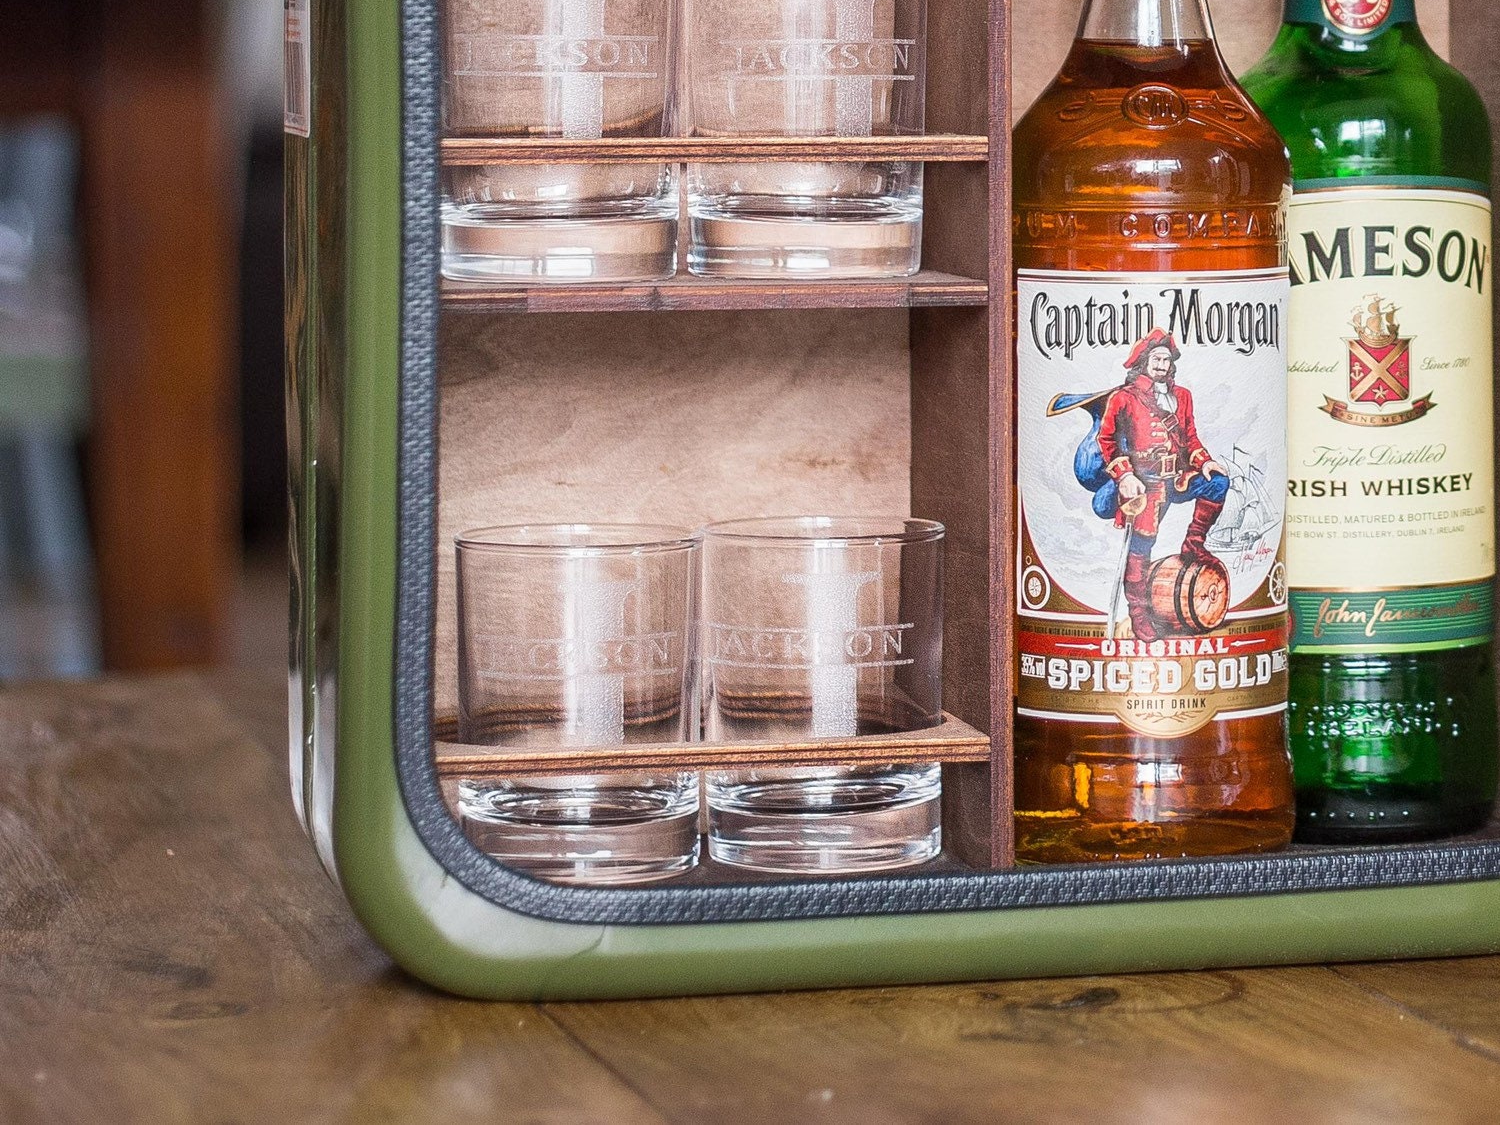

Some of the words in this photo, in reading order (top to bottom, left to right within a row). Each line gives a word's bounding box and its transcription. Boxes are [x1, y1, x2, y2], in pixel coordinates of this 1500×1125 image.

[1356, 0, 1388, 26] LIMITED
[464, 40, 649, 72] JCKSON
[735, 43, 910, 74] JACKSON
[1030, 289, 1154, 360] Captain
[1159, 288, 1281, 356] Morgan
[1287, 361, 1339, 374] blished
[1420, 356, 1450, 371] Since
[1452, 357, 1471, 369] 1780
[1346, 412, 1376, 424] SINE
[1303, 445, 1366, 474] Triple
[1367, 443, 1447, 466] Distilled
[1287, 479, 1348, 498] RISH
[1361, 473, 1473, 497] WHISKEY
[1344, 514, 1395, 525] MATURED
[1398, 514, 1405, 523] &
[1407, 510, 1450, 523] BOTTLED
[1303, 530, 1325, 539] BOW
[1398, 528, 1428, 538] DUBLIN
[1313, 597, 1367, 638] John
[714, 629, 902, 659] JACKON
[1101, 637, 1230, 657] ORIGINAL
[1048, 658, 1183, 694] SPICED
[1194, 654, 1272, 693] GOLD
[1126, 698, 1165, 710] SPIRIT
[1171, 697, 1207, 709] DRINK
